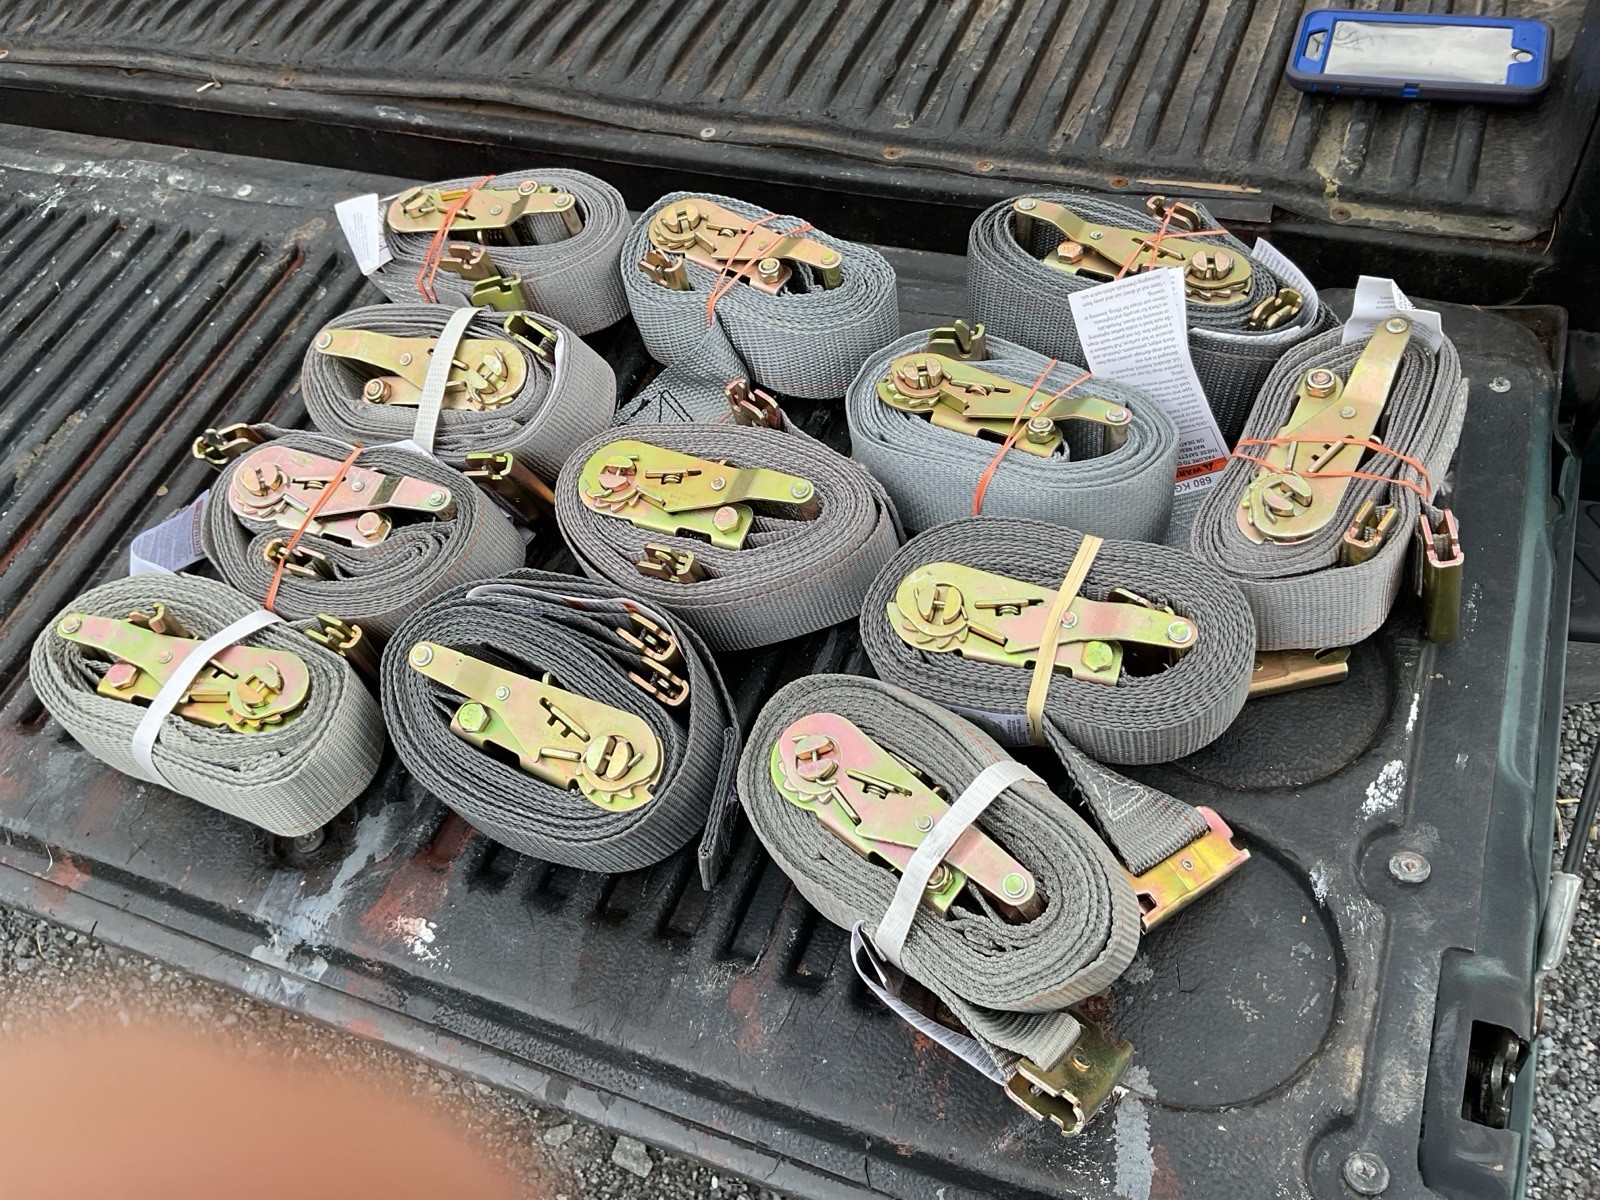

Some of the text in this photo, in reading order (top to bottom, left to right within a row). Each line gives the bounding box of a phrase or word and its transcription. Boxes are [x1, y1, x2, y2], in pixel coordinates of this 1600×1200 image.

[1178, 447, 1218, 460] THESE SAFETY
[1192, 455, 1215, 463] FAILURE
[1193, 476, 1212, 488] 680
